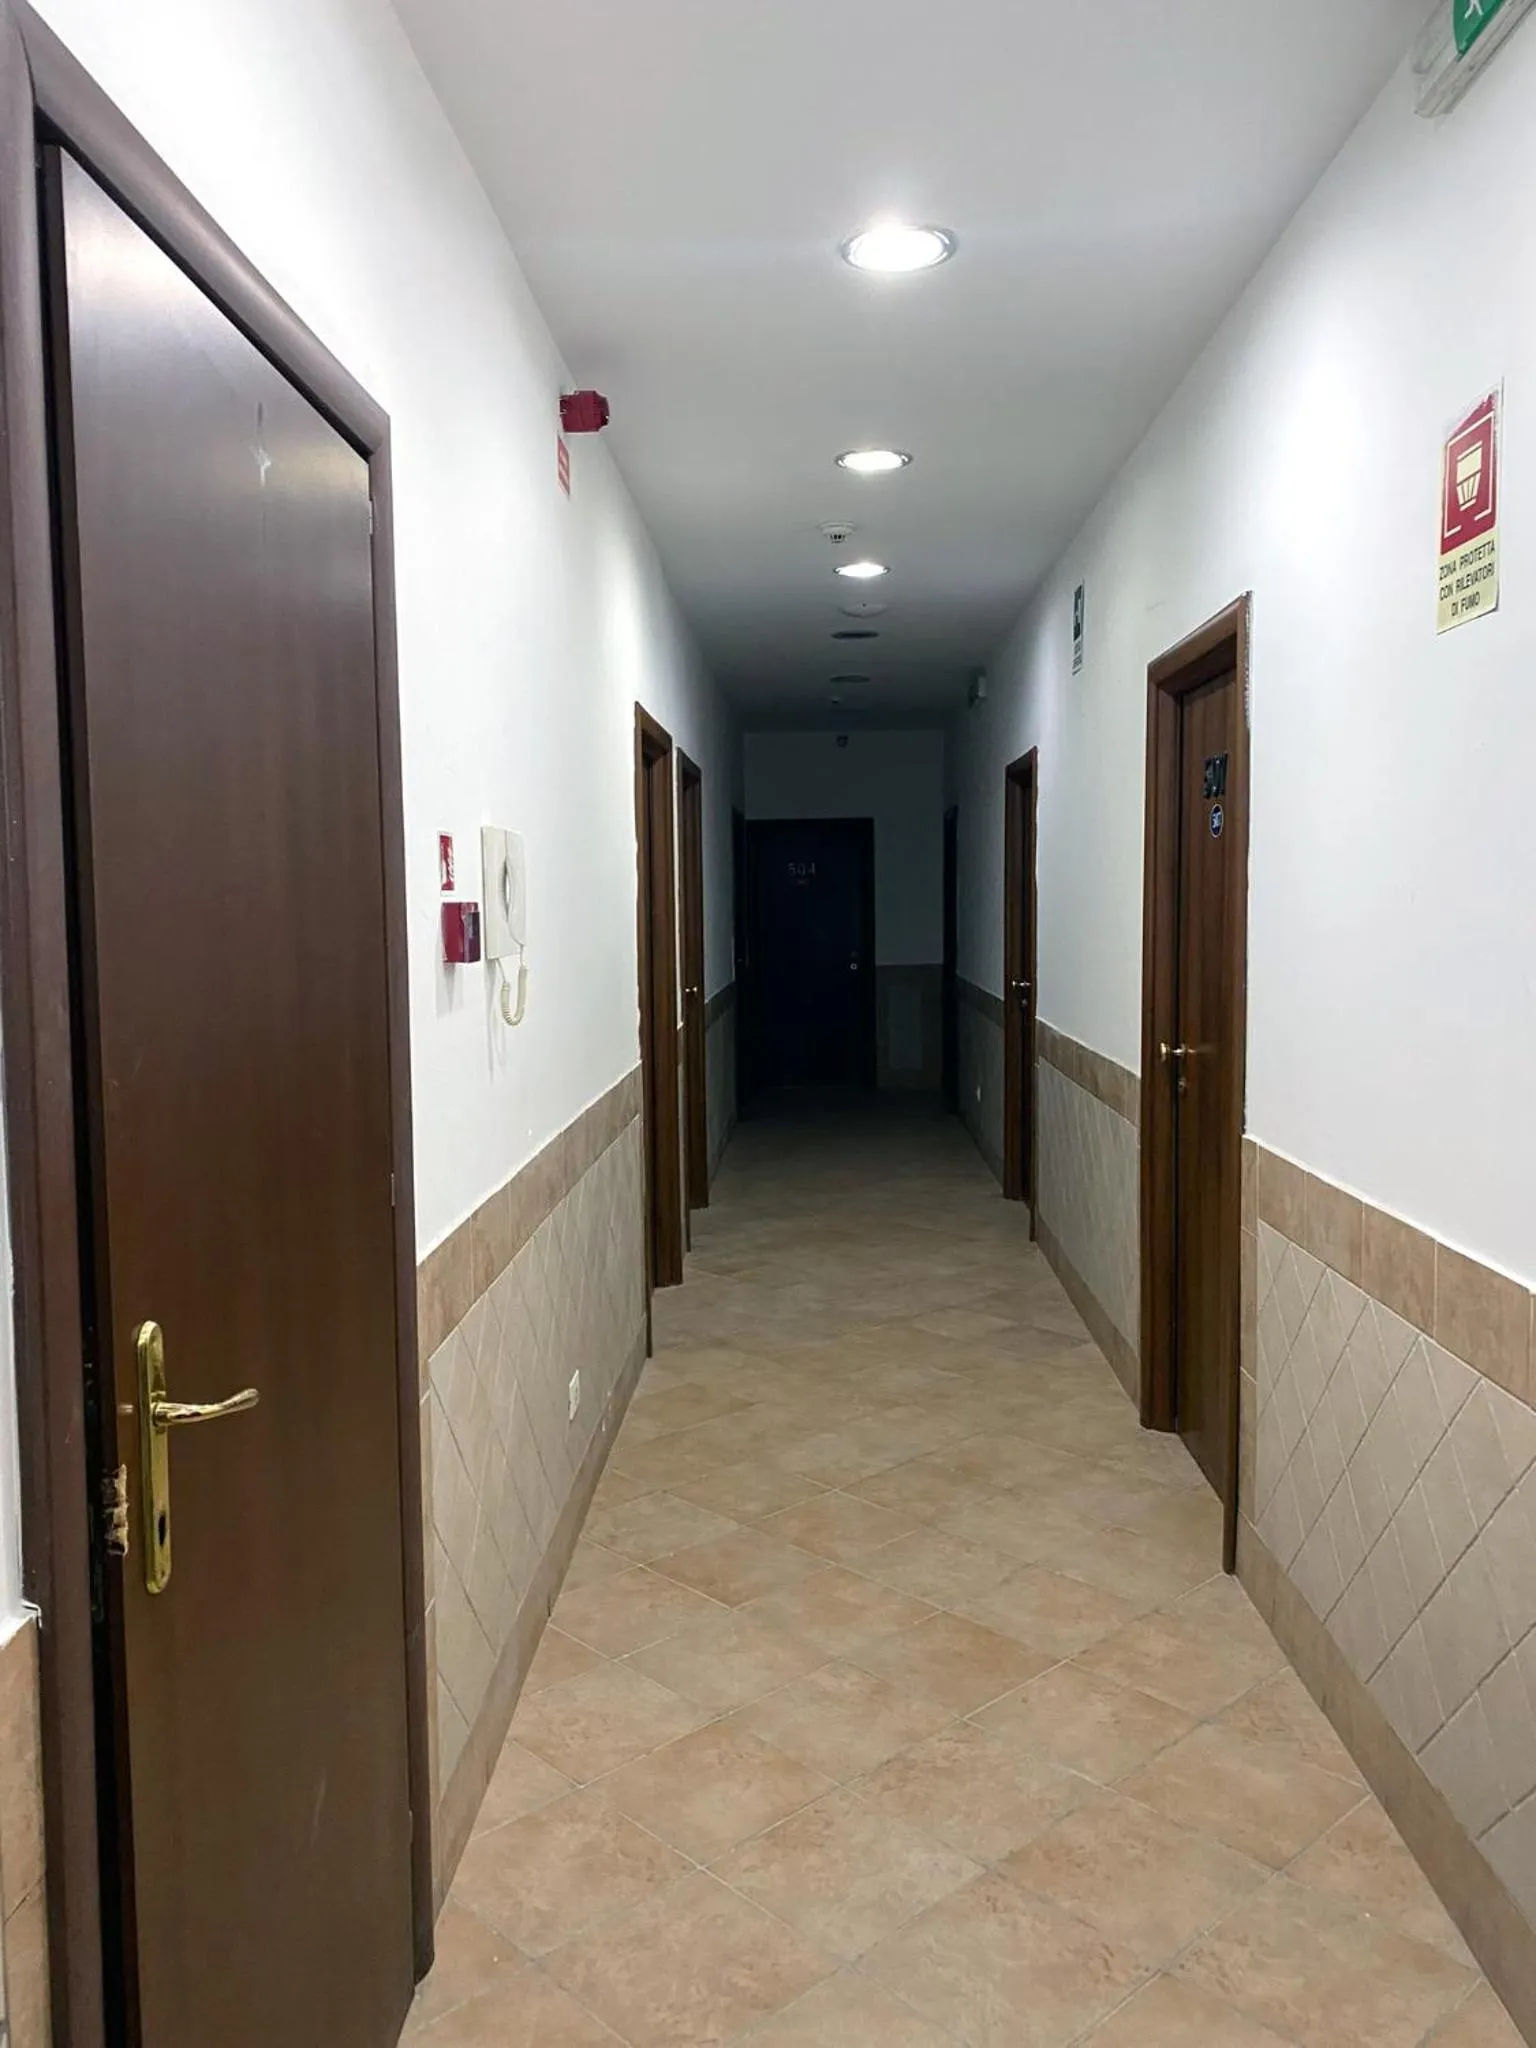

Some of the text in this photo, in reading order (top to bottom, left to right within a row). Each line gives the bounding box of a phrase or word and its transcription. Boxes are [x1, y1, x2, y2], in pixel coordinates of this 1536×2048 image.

[1440, 539, 1495, 580] ZONA PROTETTA
[1440, 561, 1495, 601] CON RILEVATORI
[1451, 591, 1480, 617] DI FUMO
